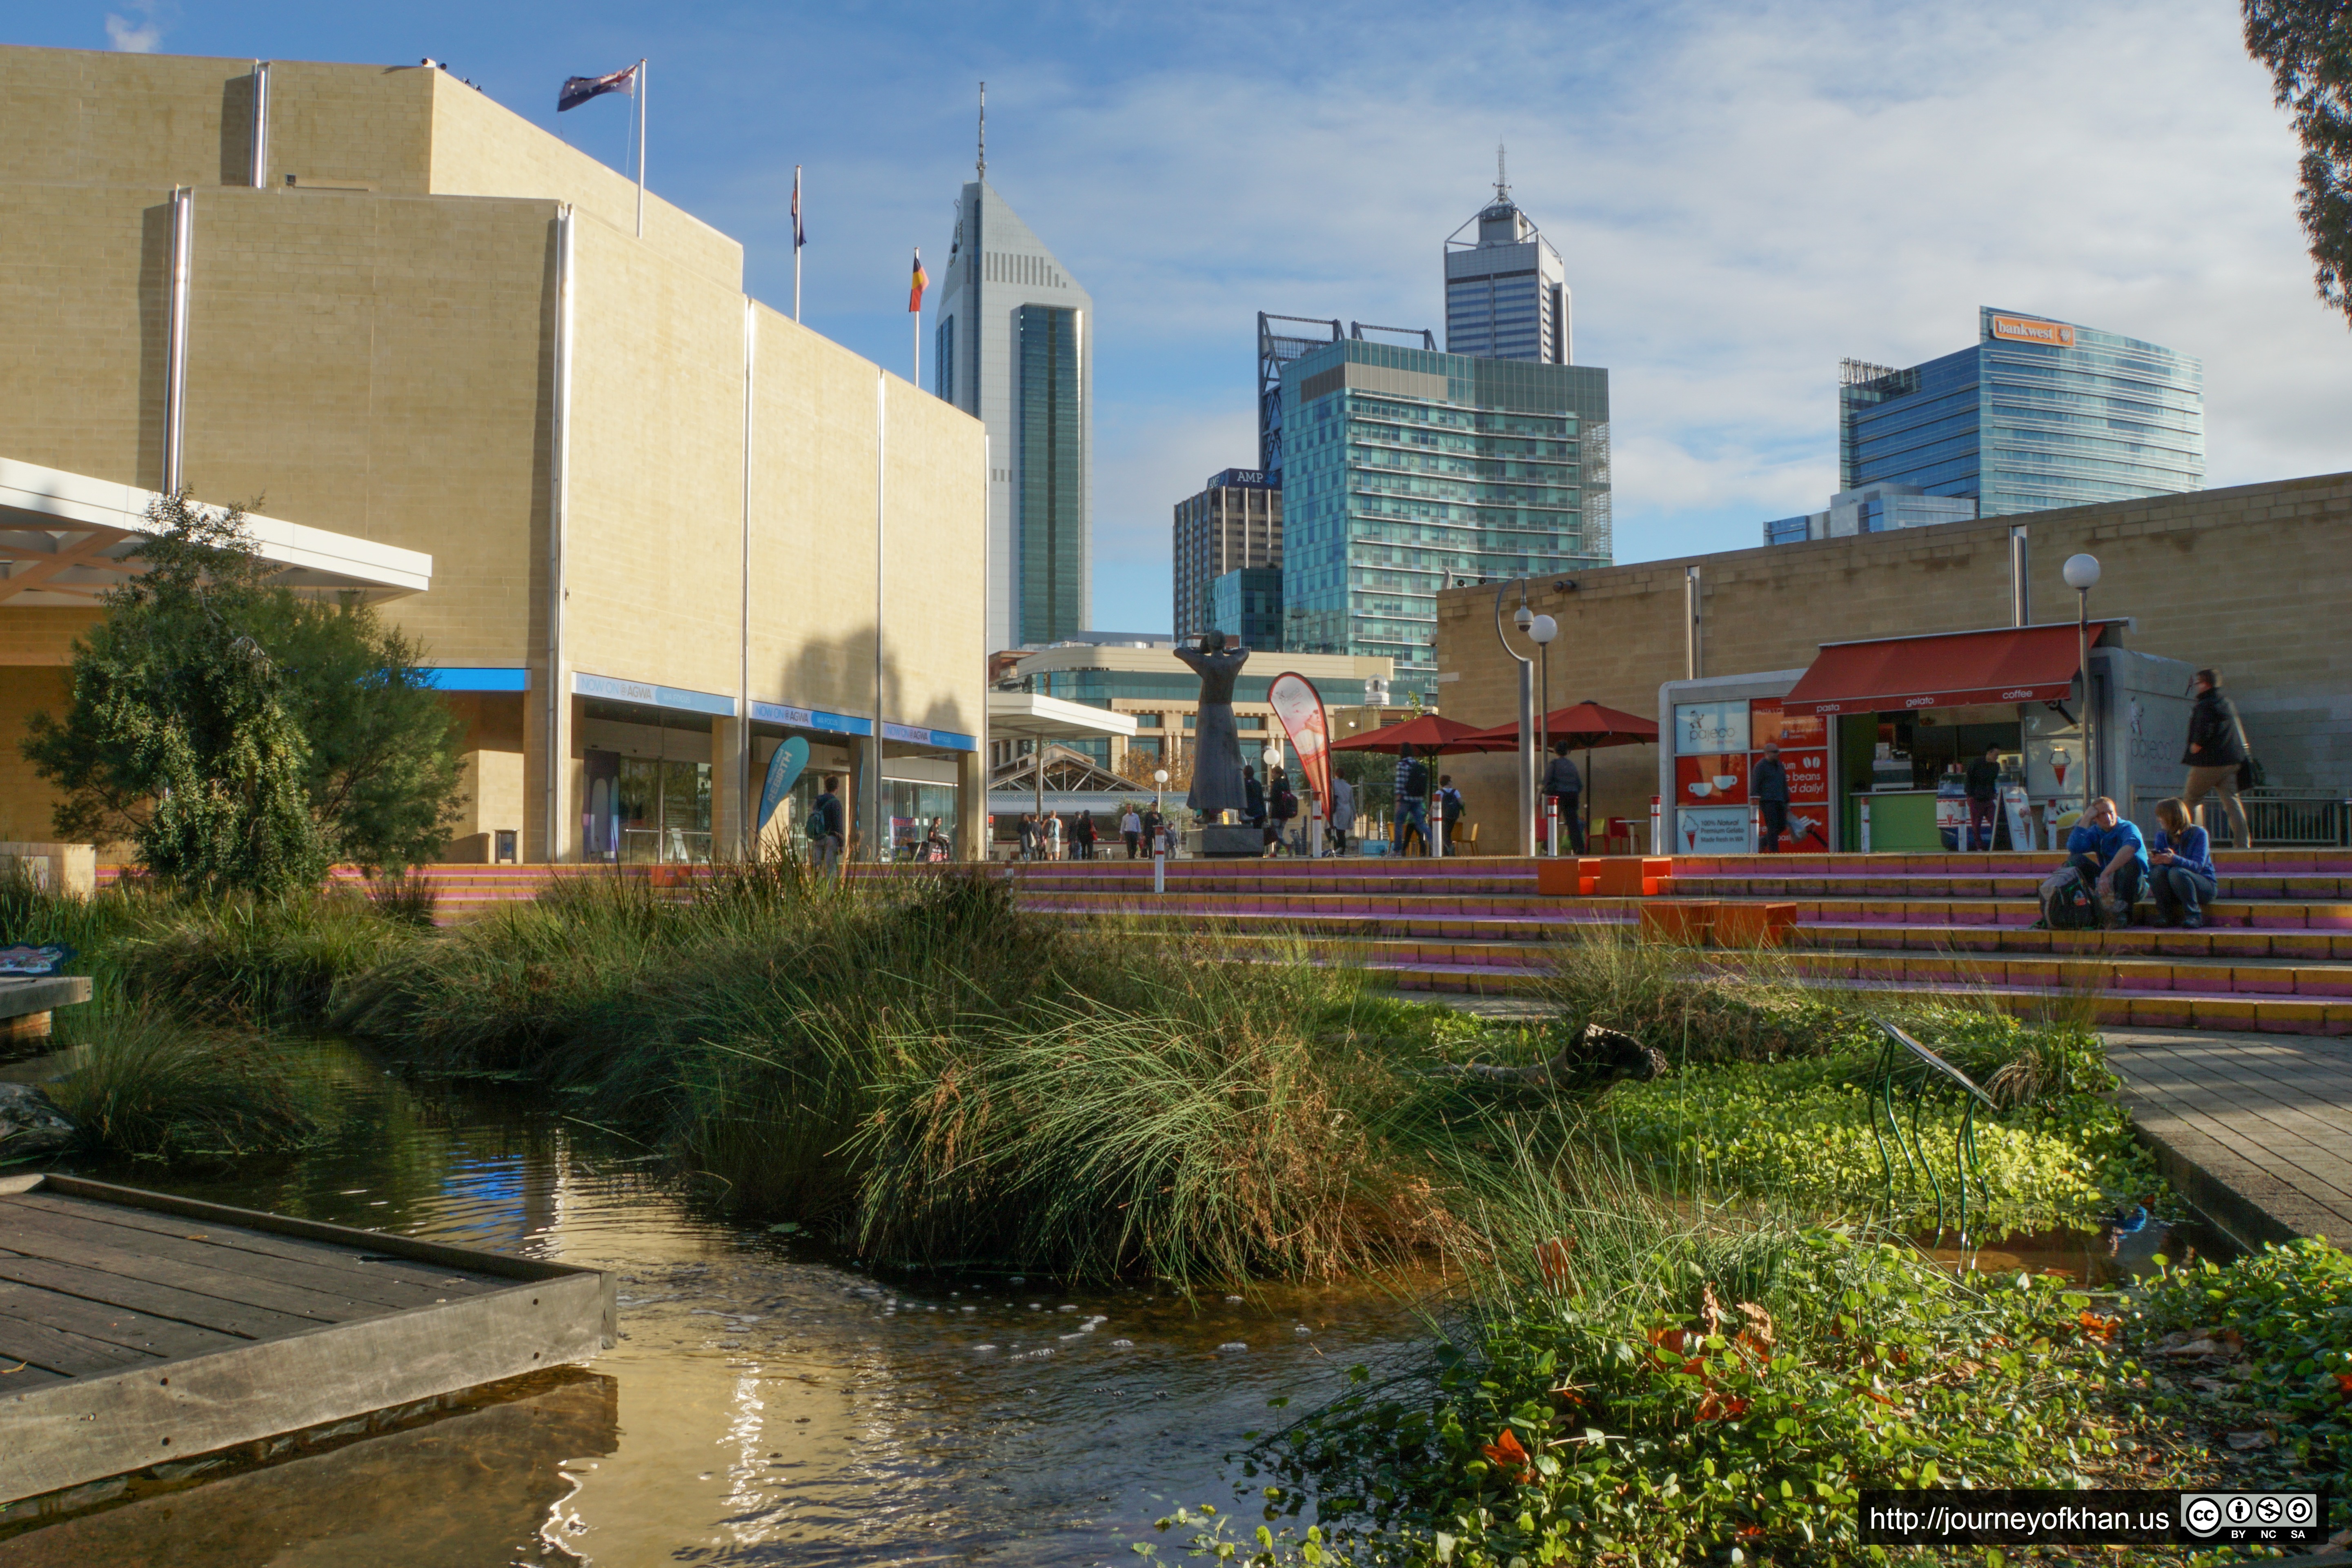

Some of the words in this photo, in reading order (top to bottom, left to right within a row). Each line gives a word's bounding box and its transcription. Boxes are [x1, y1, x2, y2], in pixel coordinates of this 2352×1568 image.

[1998, 320, 2053, 339] bankwest
[1237, 471, 1264, 483] AMP
[582, 678, 605, 692] NOW
[606, 681, 619, 694] ON
[674, 694, 691, 703] FOCUS
[2003, 689, 2033, 700] coffee
[1906, 696, 1934, 707] gelato
[756, 705, 773, 717] NOW
[773, 708, 784, 718] ON
[1816, 703, 1840, 714] pasta
[1689, 727, 1735, 743] pajeco
[768, 751, 792, 803] REBIRTH
[1792, 772, 1821, 781] beans
[1799, 782, 1824, 794] daily!
